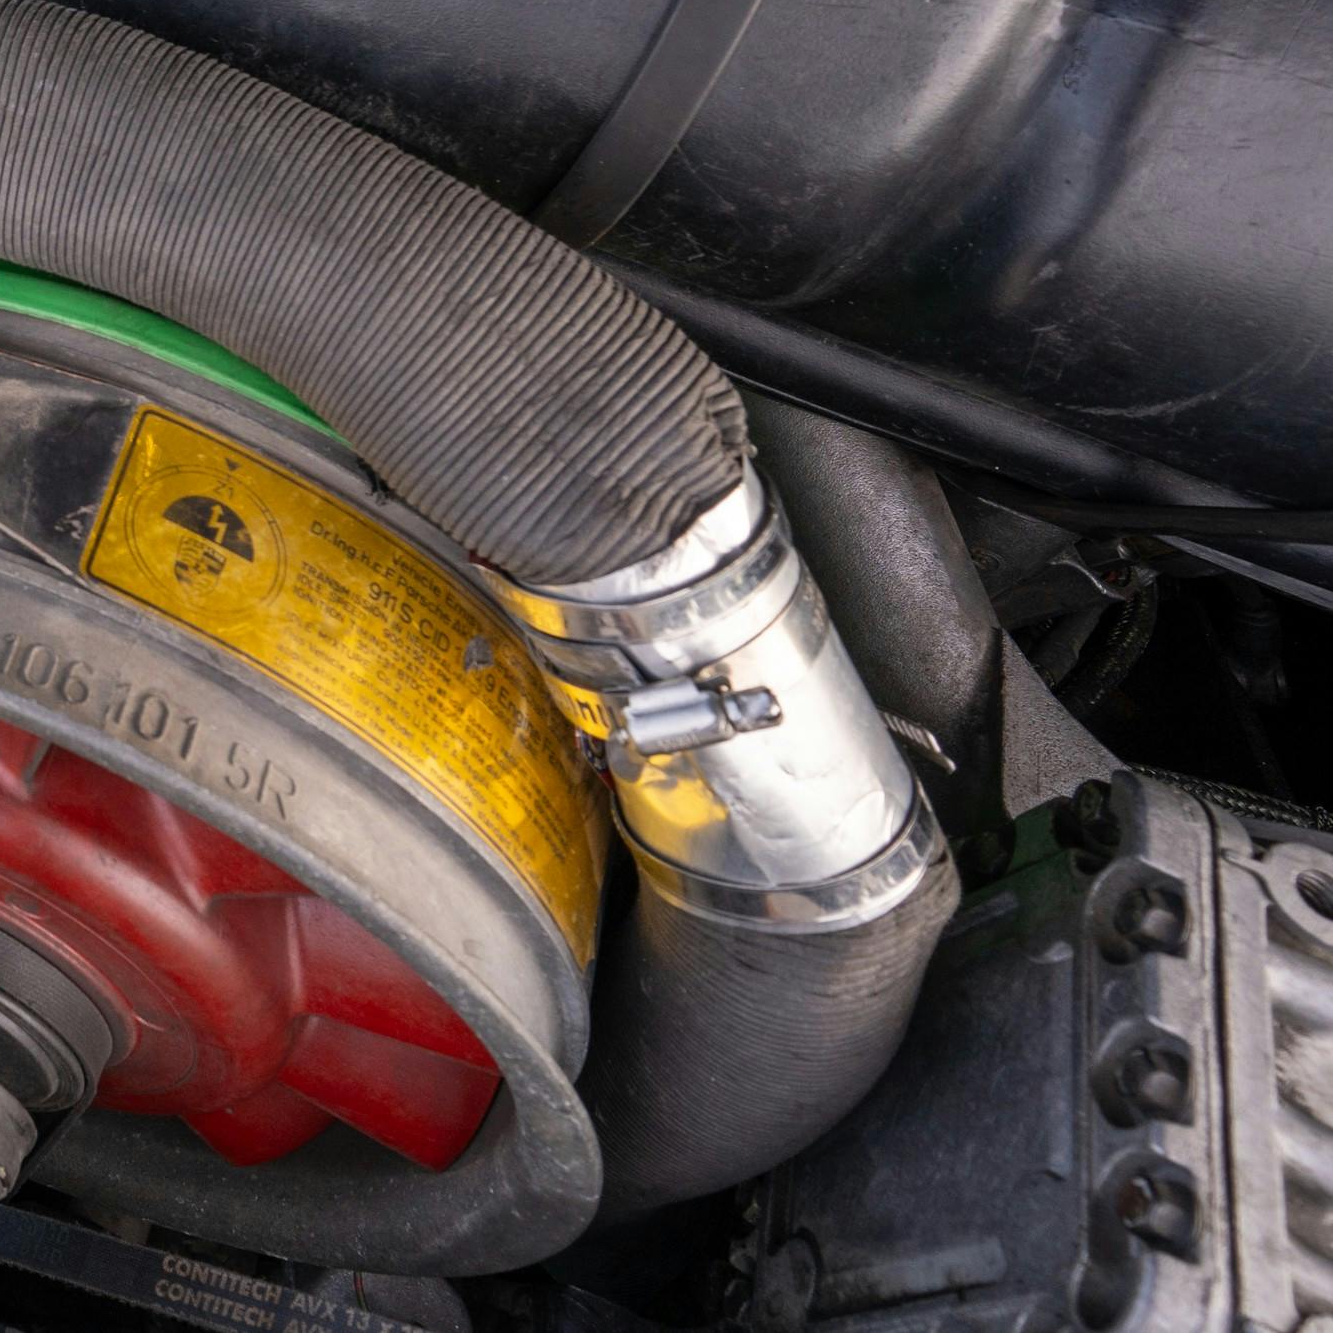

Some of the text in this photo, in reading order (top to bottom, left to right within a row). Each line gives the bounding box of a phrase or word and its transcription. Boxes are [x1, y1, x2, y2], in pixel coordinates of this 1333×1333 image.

[213, 478, 235, 501] Z1
[298, 559, 391, 625] TRANSMISSION
[416, 613, 452, 658] CID
[103, 680, 202, 763] 101
[153, 1278, 277, 1330] CONTITECH
[161, 1254, 283, 1306] CONTITECH
[289, 1291, 337, 1321] AVX
[345, 1306, 372, 1330] 13
